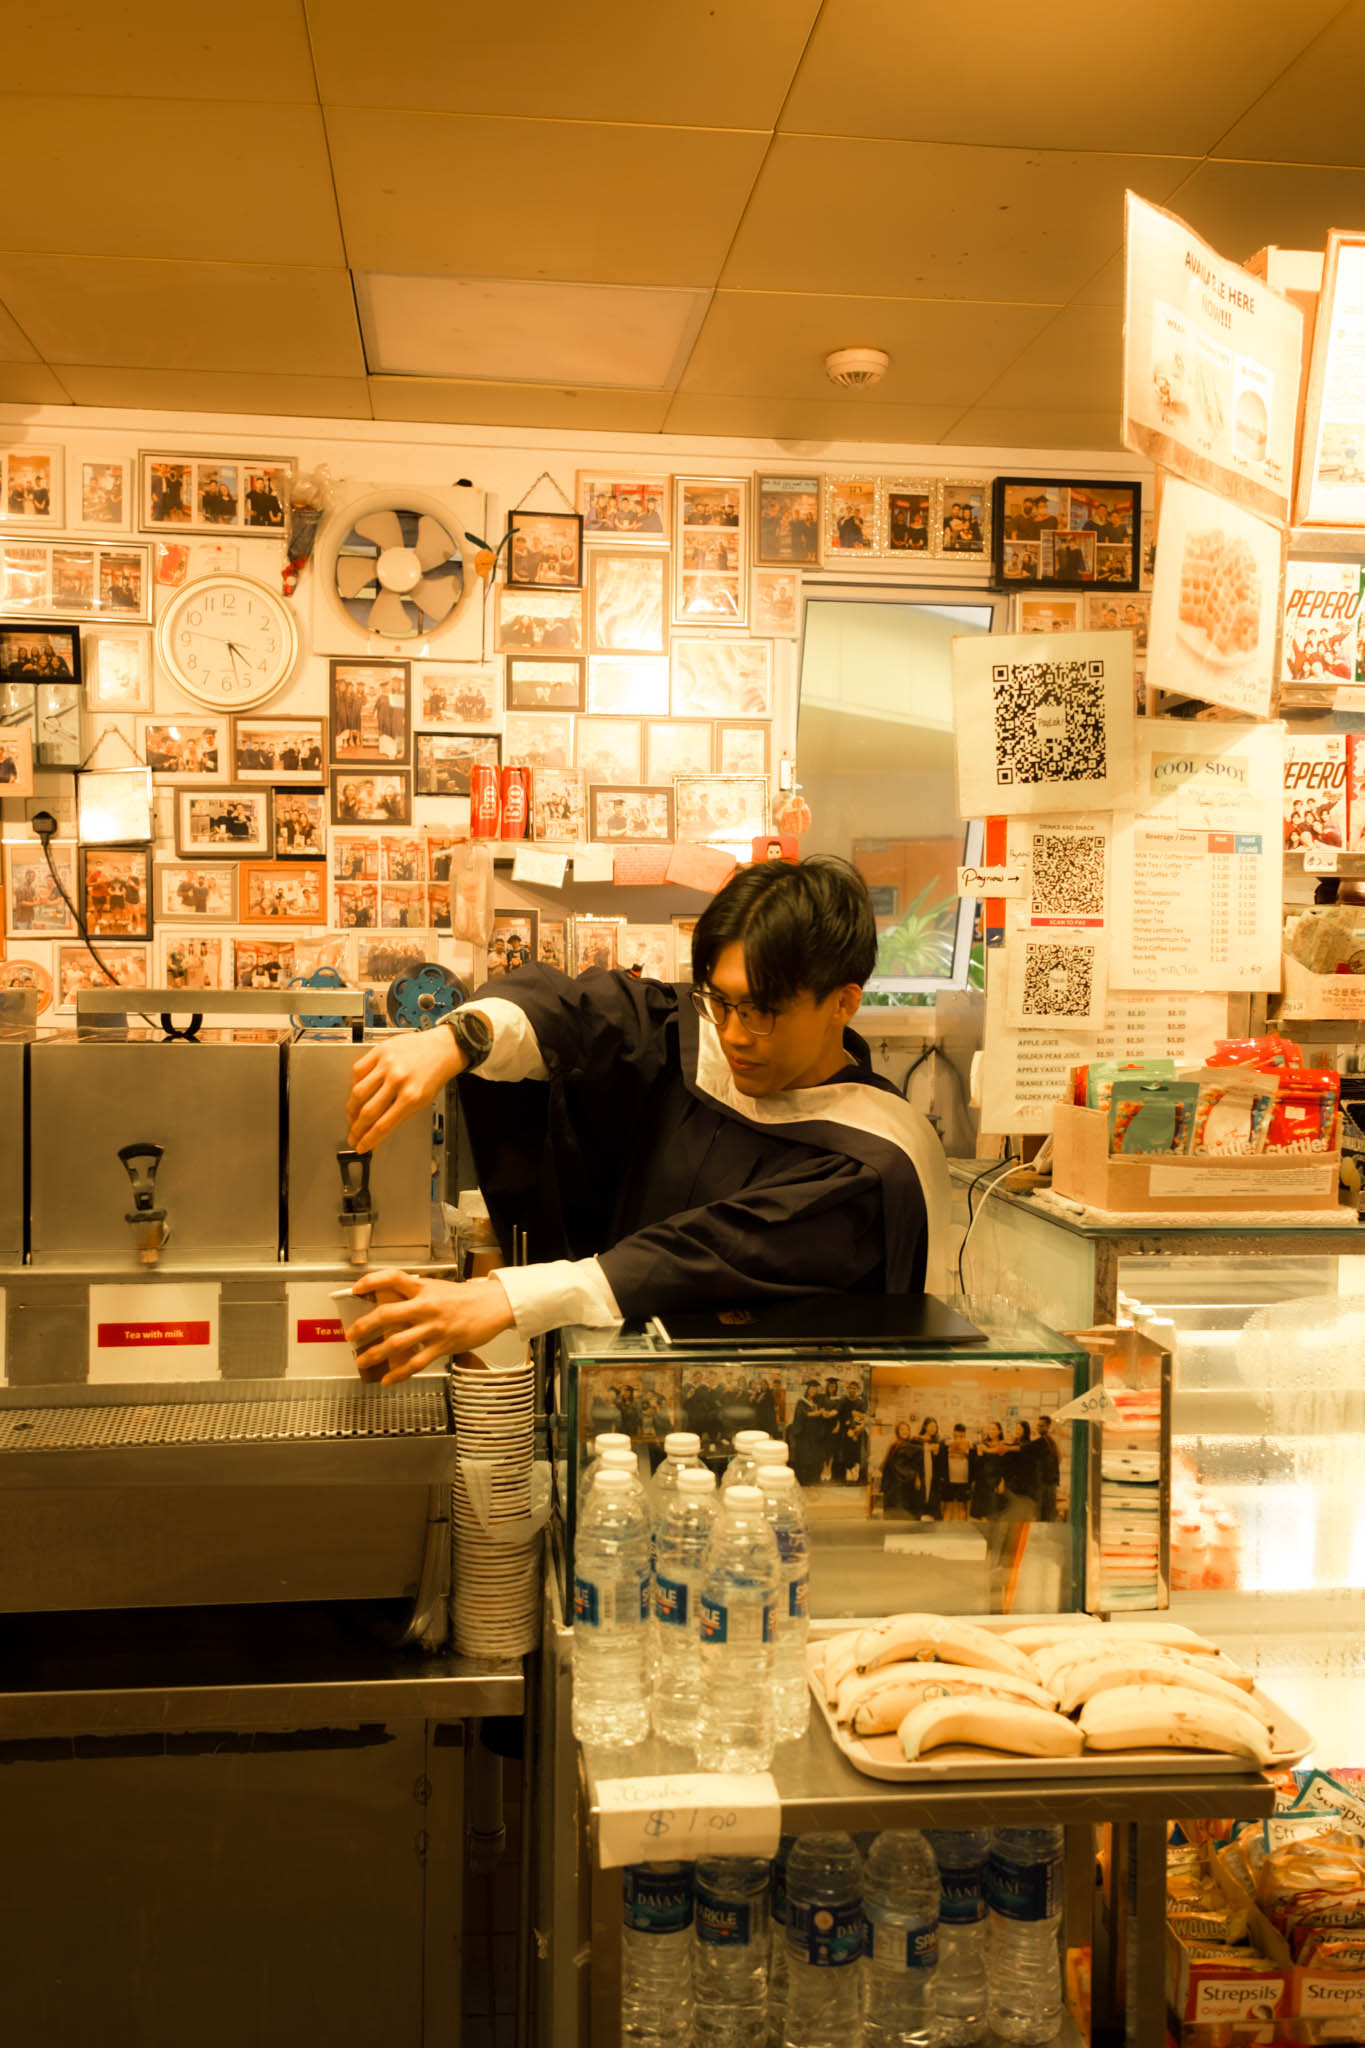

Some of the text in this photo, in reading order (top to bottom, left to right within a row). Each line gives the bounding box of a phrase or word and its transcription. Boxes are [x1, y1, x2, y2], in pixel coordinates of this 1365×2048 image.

[1228, 287, 1254, 314] HERE
[204, 596, 215, 612] 11
[223, 592, 236, 609] 12
[1286, 588, 1360, 620] PEPERO
[186, 611, 202, 626] 10
[260, 616, 270, 631] 2
[181, 631, 192, 647] 9
[264, 639, 276, 653] 3
[187, 654, 197, 670] 8
[257, 658, 267, 673] 4
[202, 670, 211, 685] 7
[221, 676, 232, 692] 6
[243, 673, 251, 688] 5
[1154, 760, 1245, 783] COOL SPOT
[1283, 761, 1348, 790] EPERO
[503, 784, 525, 823] Bro
[1145, 833, 1174, 842] Beverage
[1015, 1093, 1041, 1101] GOLDEN
[124, 1329, 185, 1340] Tea with milk
[315, 1326, 345, 1336] Tea wi
[1203, 1985, 1278, 2004] Strepsils
[1307, 1984, 1365, 2003] Streps
[1201, 2006, 1241, 2017] Original
